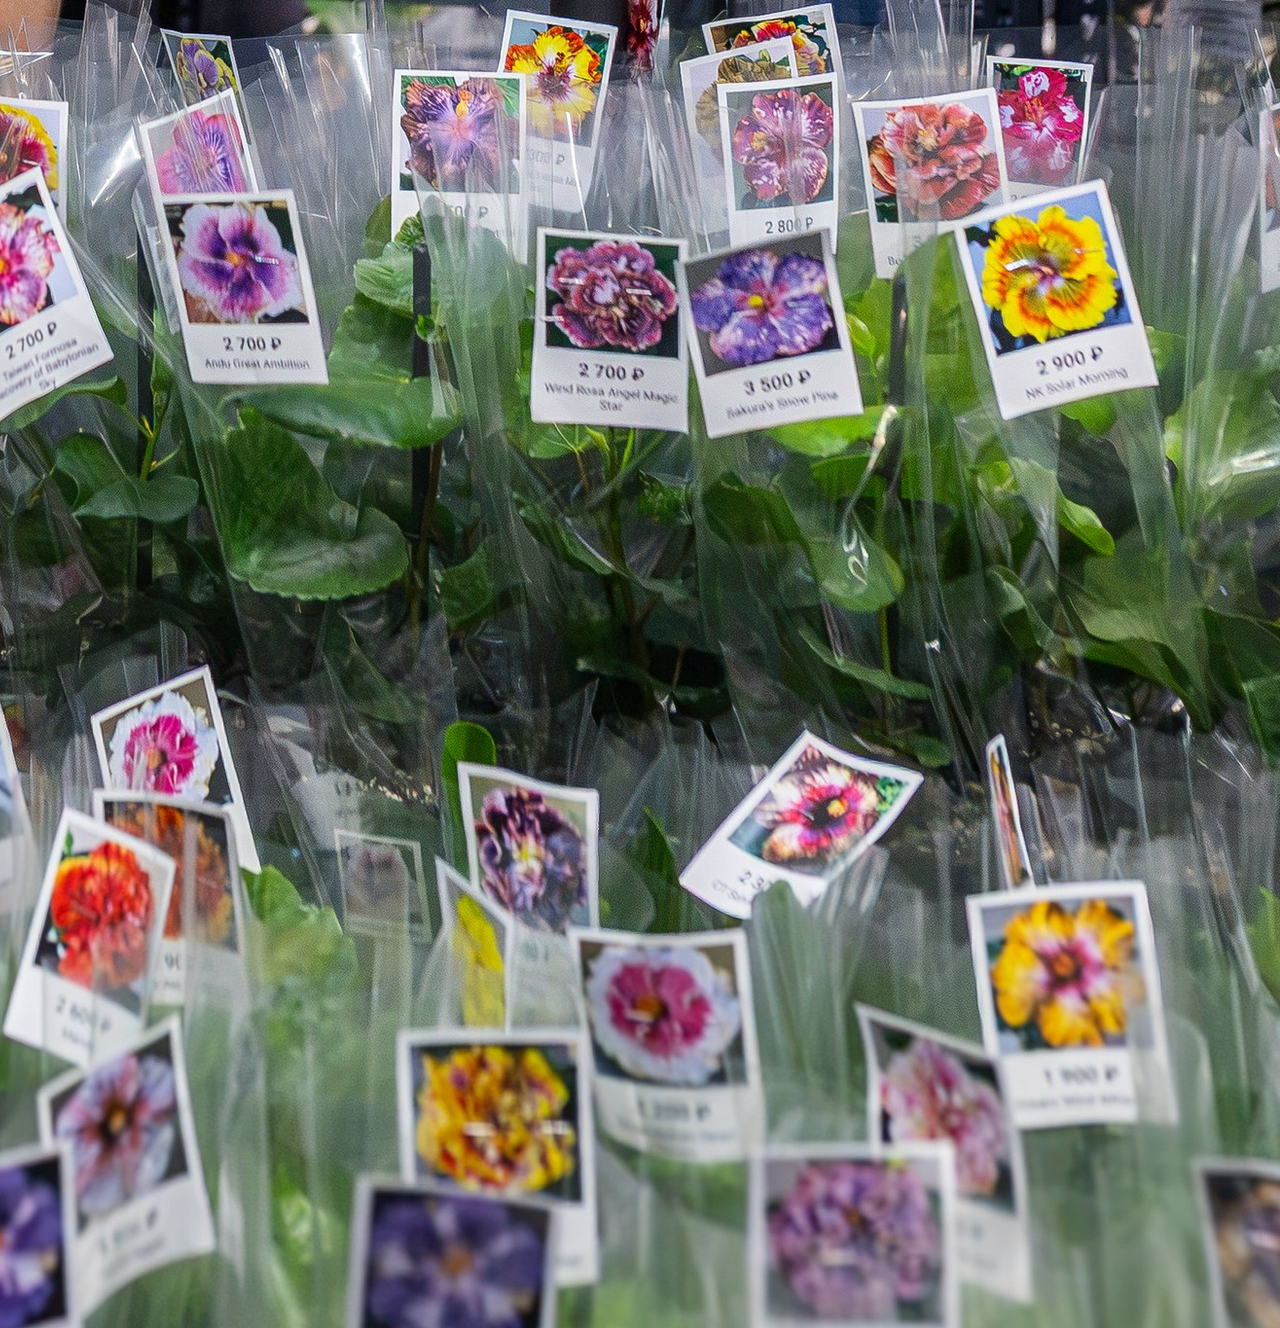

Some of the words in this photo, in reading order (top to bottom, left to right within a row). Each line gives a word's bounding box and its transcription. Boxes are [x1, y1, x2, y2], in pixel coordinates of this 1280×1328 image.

[765, 221, 774, 234] 2
[5, 344, 16, 360] 2
[19, 329, 44, 352] 700
[223, 337, 234, 351] 2
[237, 337, 266, 351] 700
[578, 363, 590, 377] 2
[595, 363, 626, 381] 700
[1036, 359, 1048, 376] 2
[1053, 350, 1086, 371] 900
